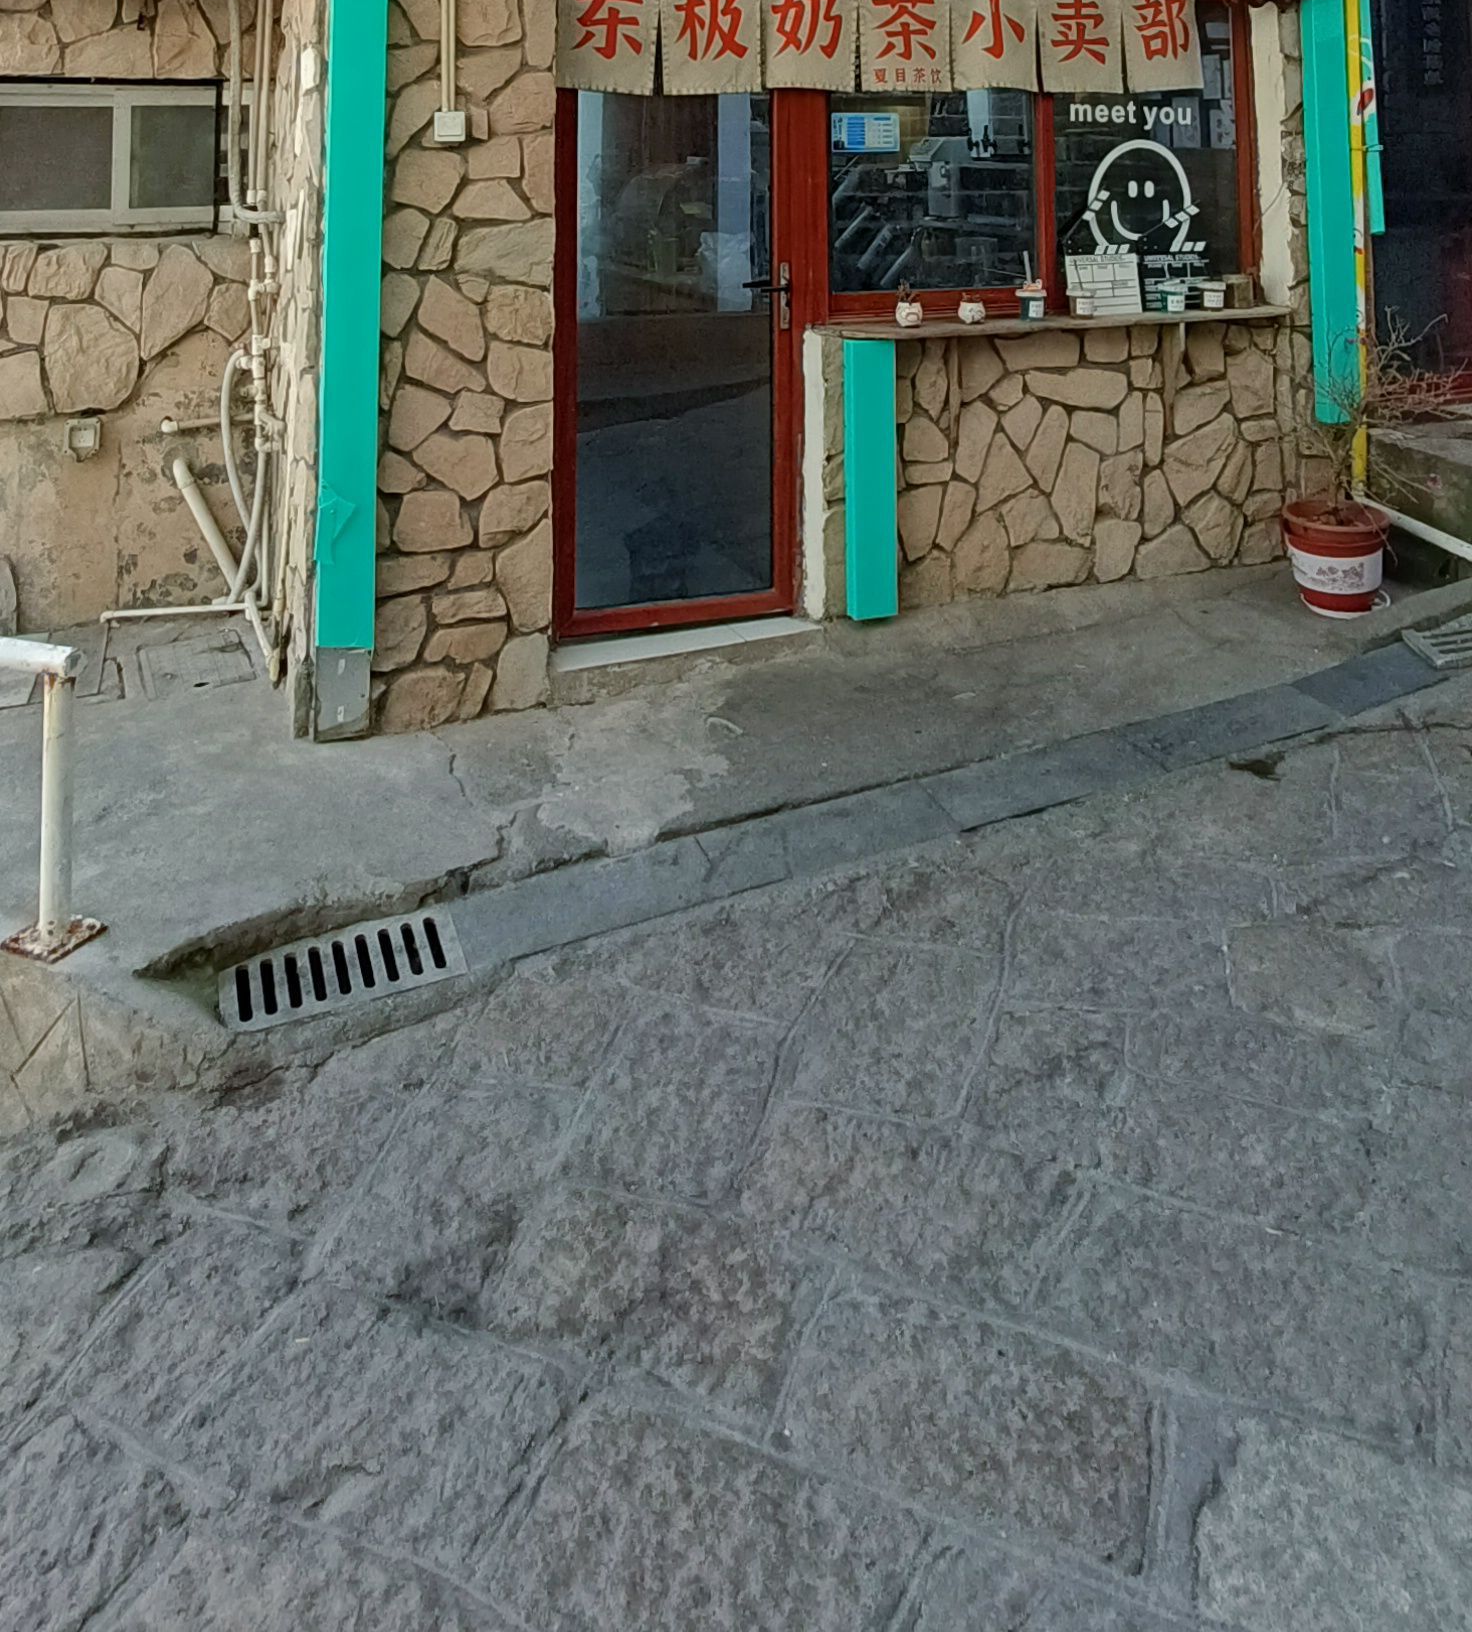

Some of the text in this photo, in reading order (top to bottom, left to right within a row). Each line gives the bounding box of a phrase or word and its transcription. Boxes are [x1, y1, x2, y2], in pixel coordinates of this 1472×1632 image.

[873, 67, 943, 84] 夏目茶饮
[1069, 101, 1193, 130] meet you
